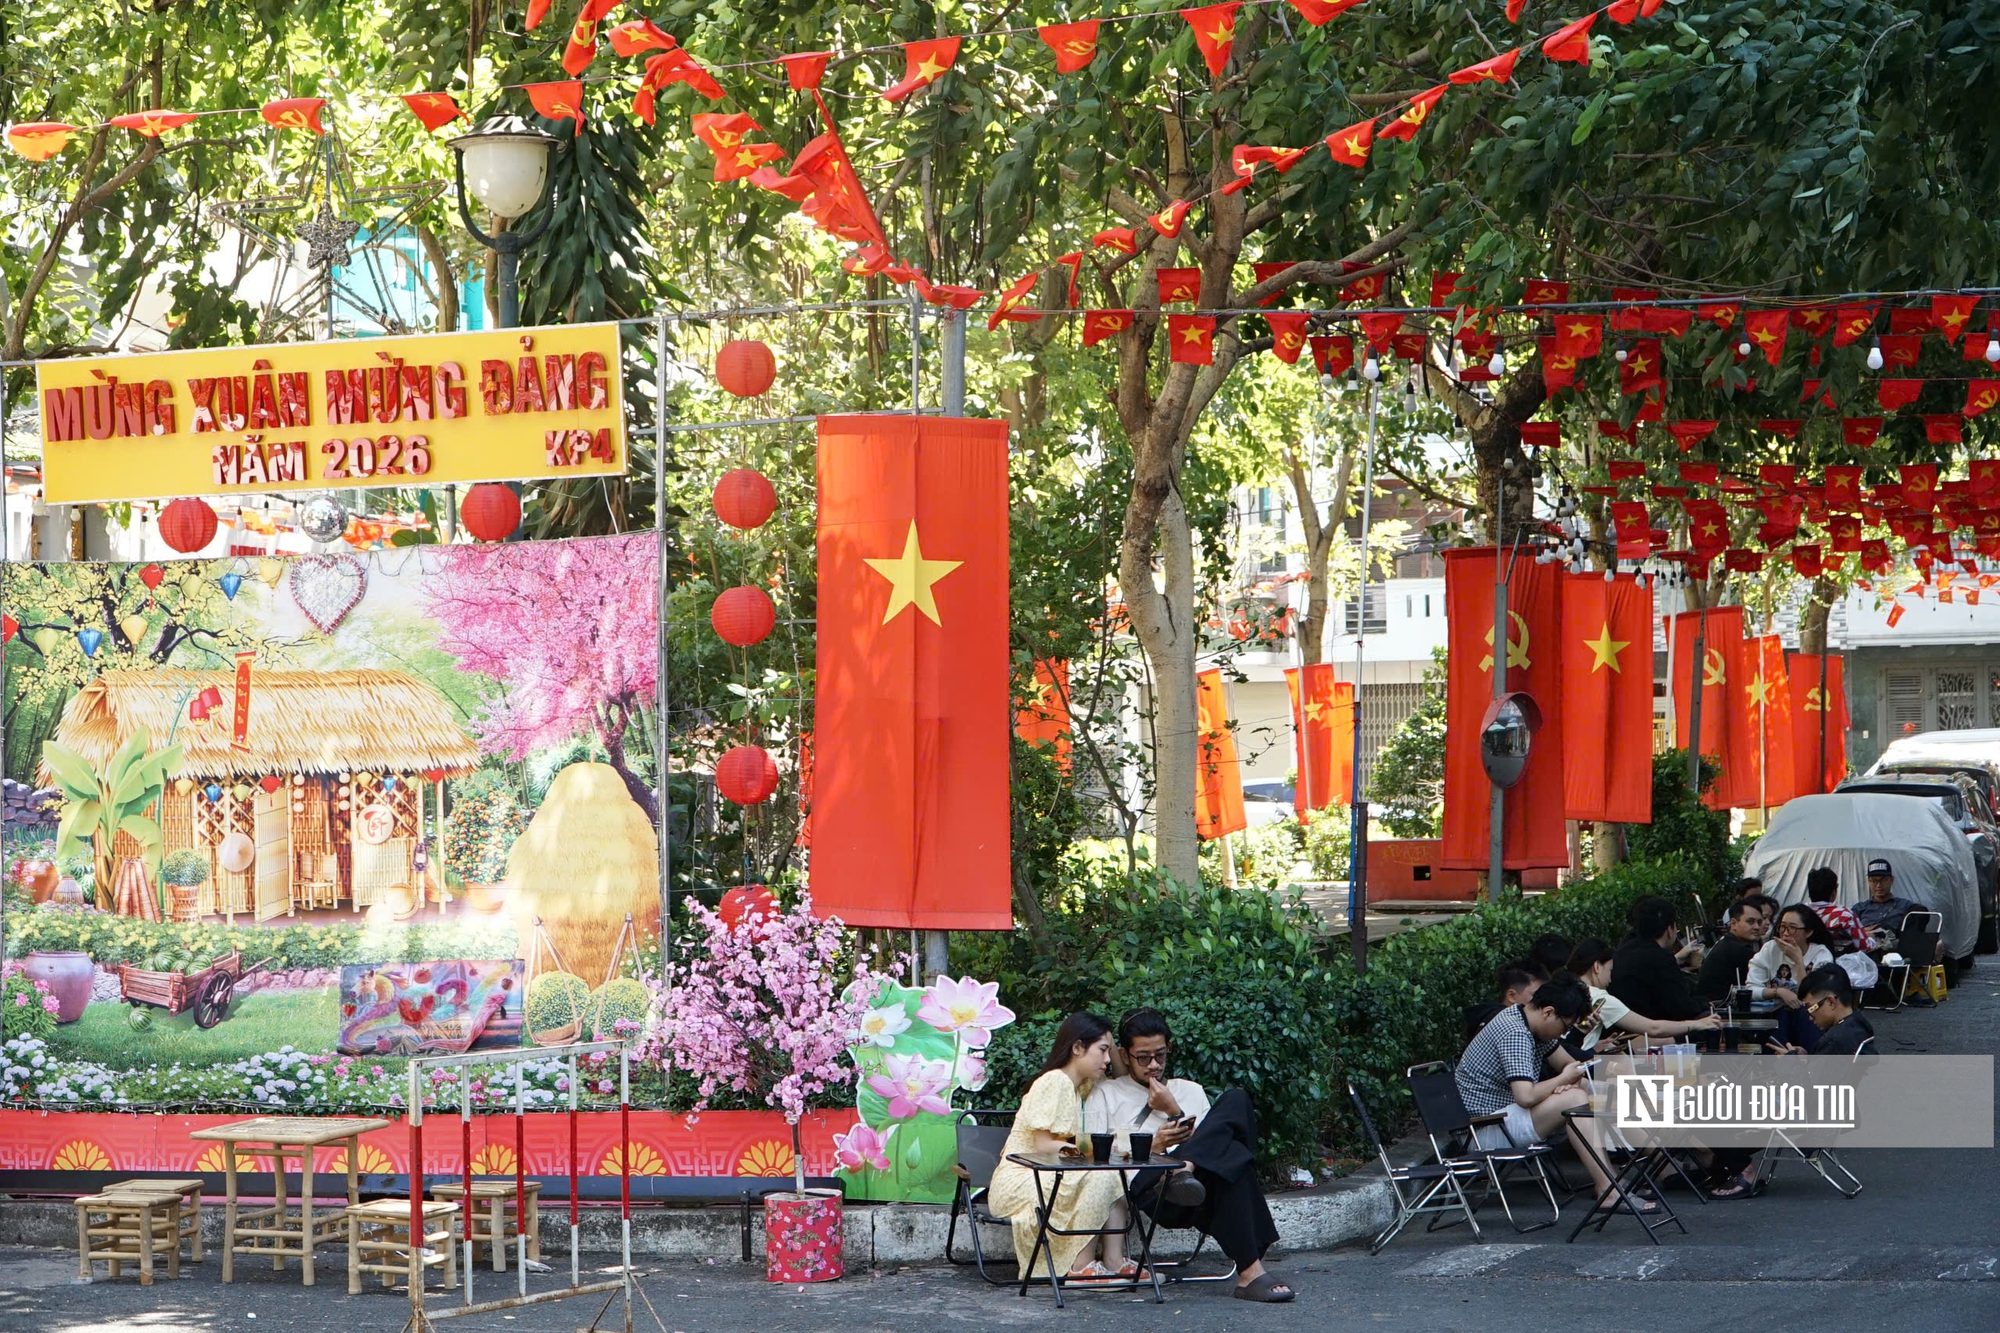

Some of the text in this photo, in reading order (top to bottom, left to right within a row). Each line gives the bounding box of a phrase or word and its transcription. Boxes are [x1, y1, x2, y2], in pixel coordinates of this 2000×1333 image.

[44, 335, 610, 442] MỪNG XUÂN MỪNG ĐẢNG
[212, 434, 432, 485] NĂM 2026
[545, 427, 615, 467] KP4
